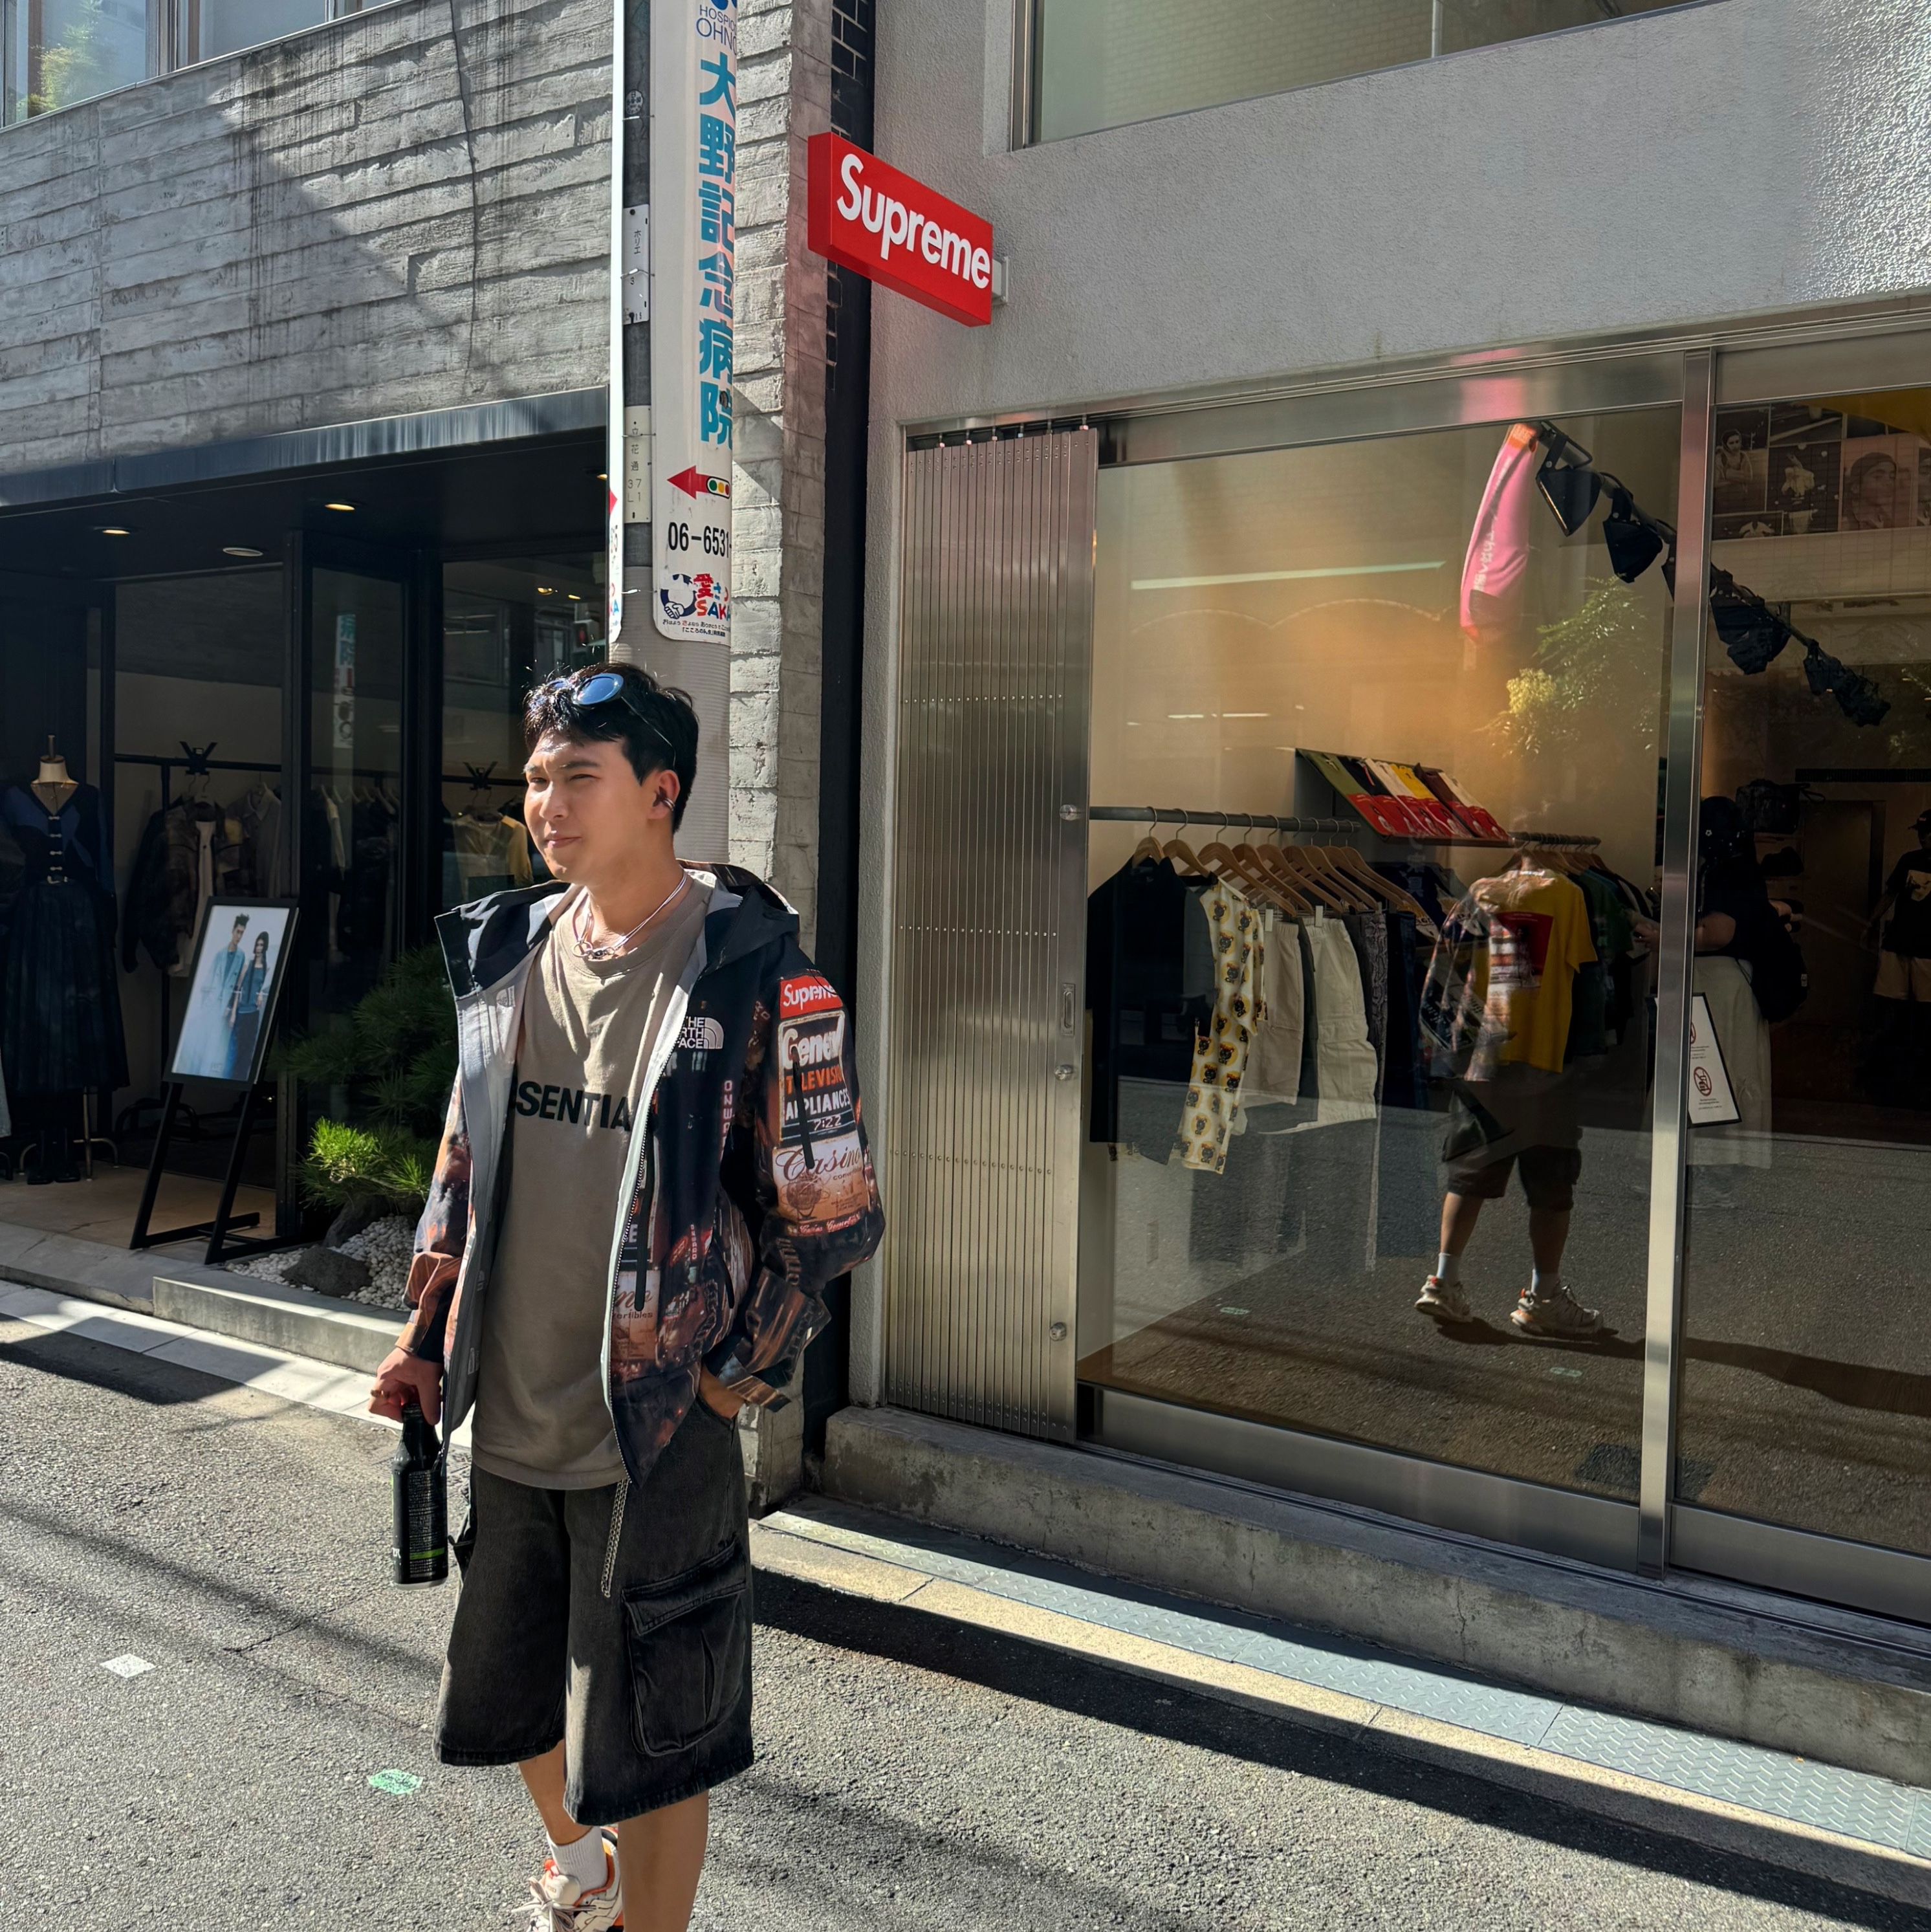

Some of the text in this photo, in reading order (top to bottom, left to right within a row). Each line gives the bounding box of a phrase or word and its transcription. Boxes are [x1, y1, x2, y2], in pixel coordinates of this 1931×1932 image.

[837, 154, 990, 289] Supreme
[686, 1016, 704, 1027] HE
[677, 1038, 704, 1049] ACE
